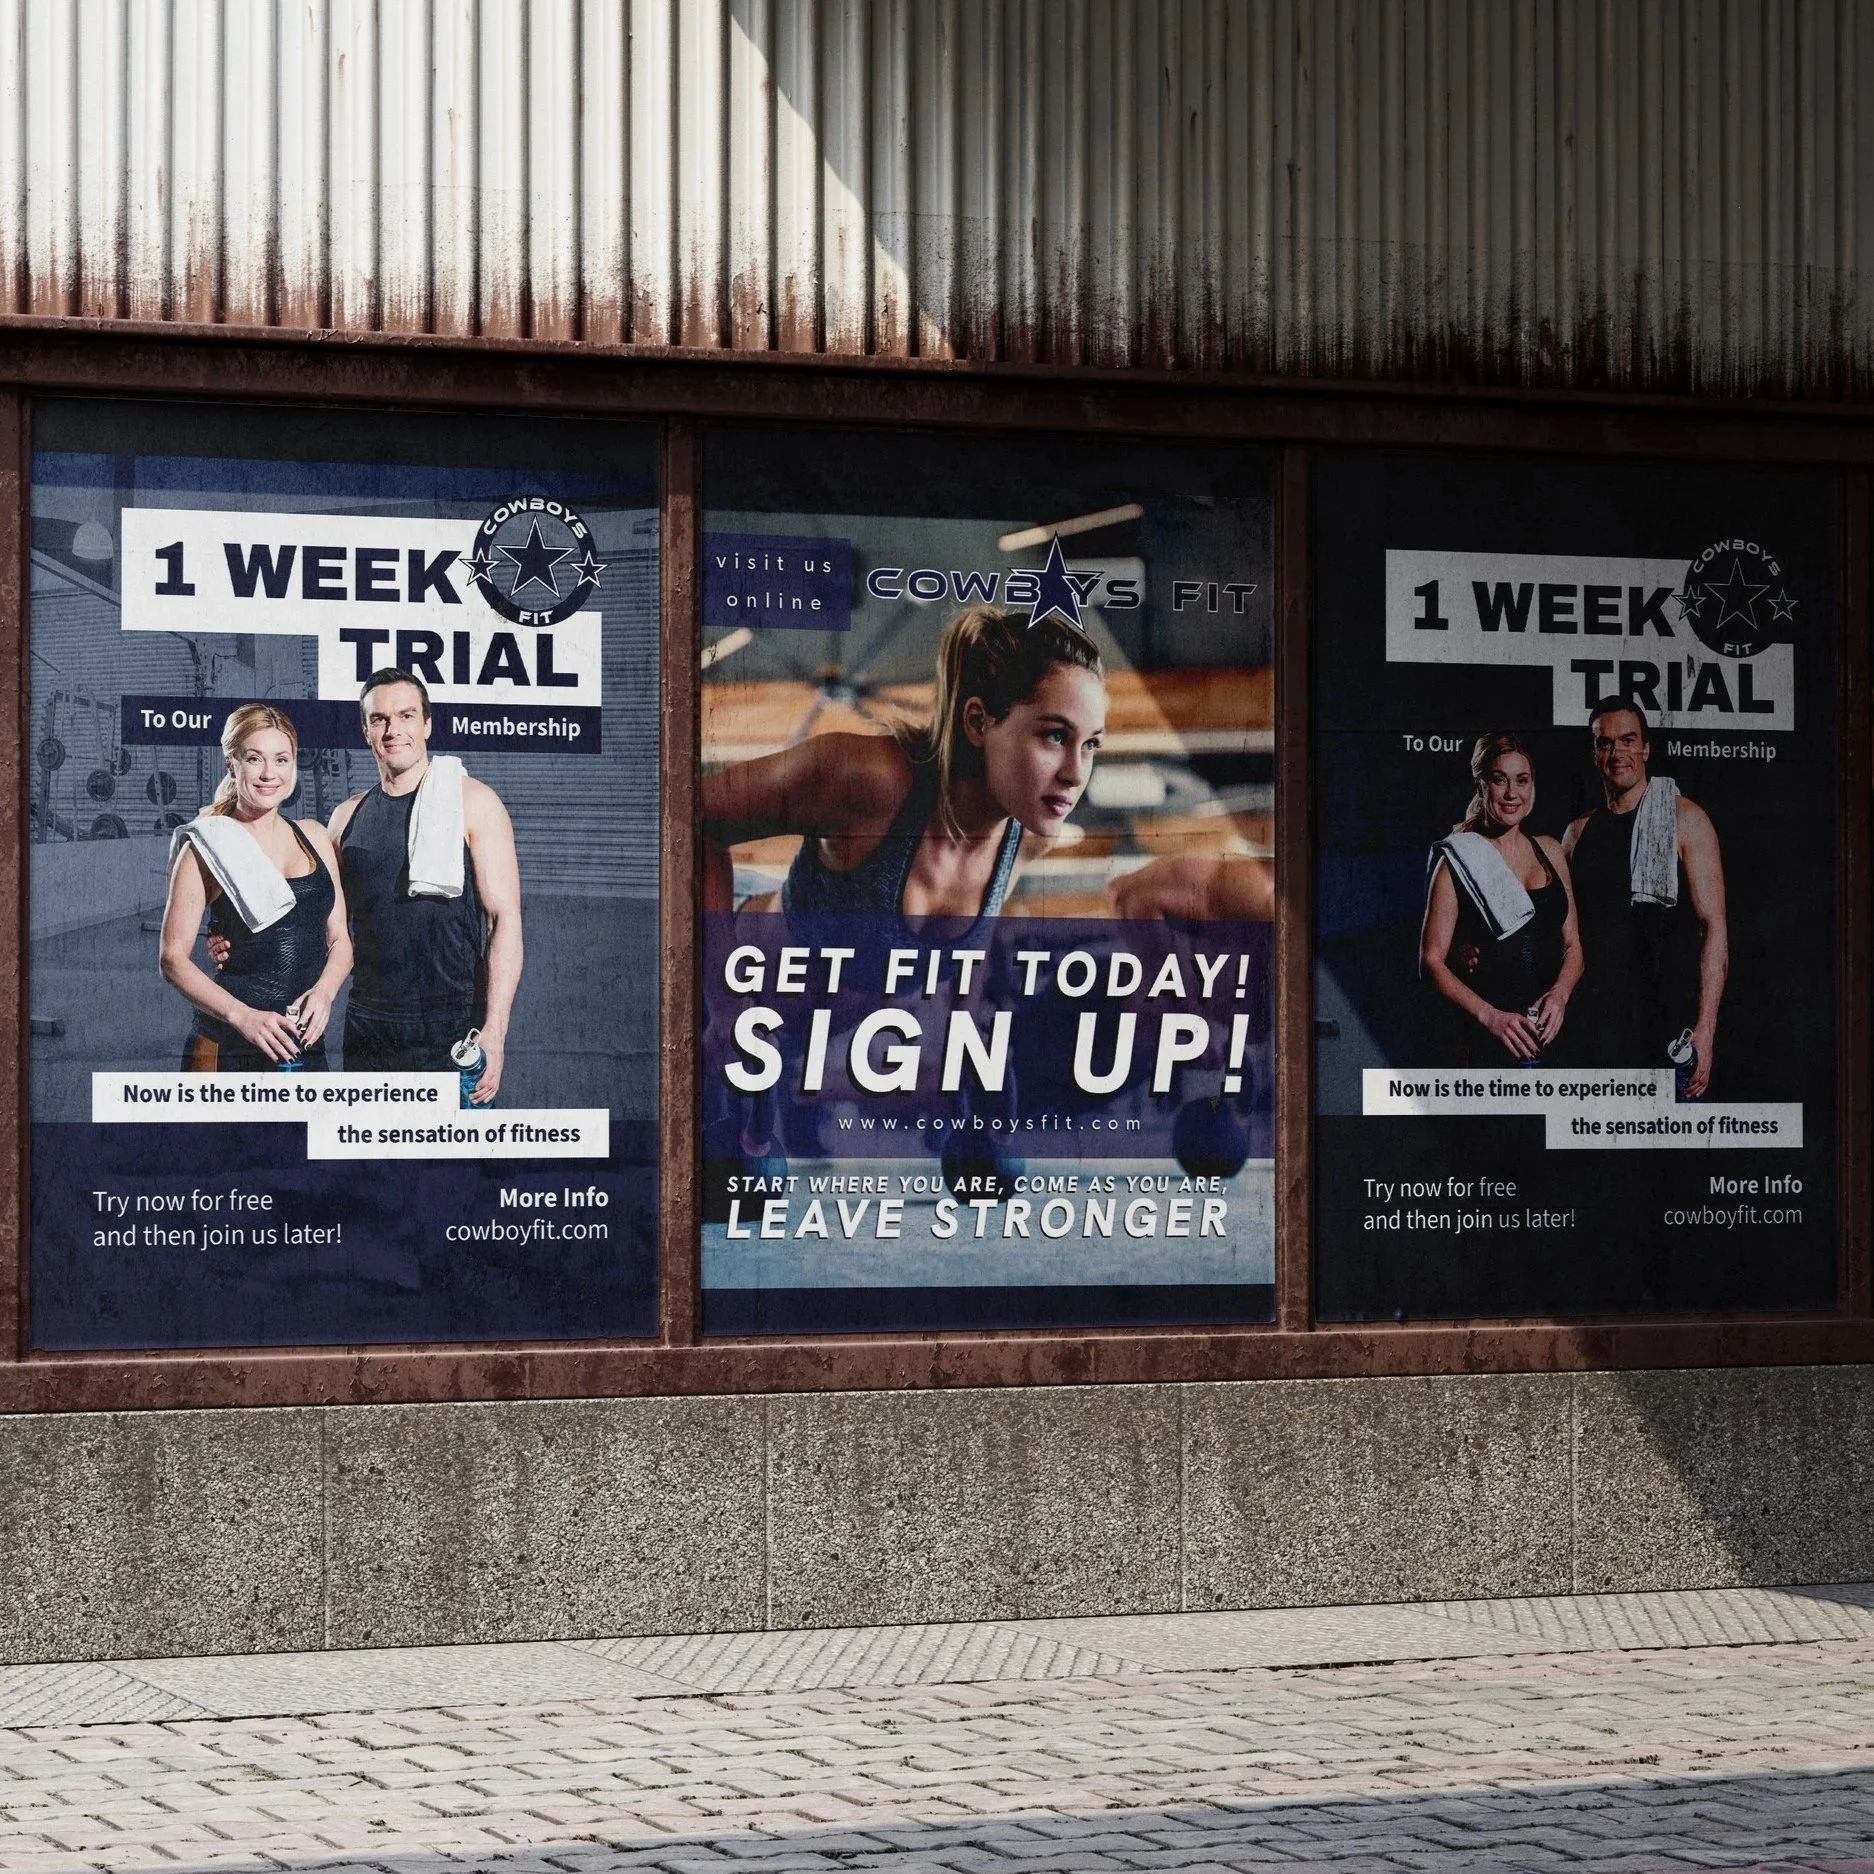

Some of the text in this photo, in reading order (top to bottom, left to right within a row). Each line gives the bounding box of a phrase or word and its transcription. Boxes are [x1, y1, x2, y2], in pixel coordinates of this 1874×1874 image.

[483, 497, 589, 539] COWBOYS
[716, 554, 832, 572] visit us
[1693, 539, 1782, 577] COWBOYS
[155, 541, 463, 604] 1 WEEK
[727, 591, 821, 611] online
[1173, 580, 1257, 614] FIT
[1413, 580, 1676, 637] 1 WEEK
[519, 610, 553, 625] FIT
[339, 628, 579, 688] TRIAL
[1723, 642, 1752, 655] FIT
[1570, 658, 1775, 714] TRIAL
[141, 710, 212, 730] To Our
[452, 717, 581, 741] Membership
[1403, 735, 1463, 752] To Our
[1668, 741, 1776, 762] Membership
[724, 945, 1251, 999] GET FIT TODAY!
[724, 1006, 1249, 1093] SIGN UP!
[123, 1084, 438, 1106] Now is the time to experience
[1389, 1079, 1657, 1100] Now is the time to experience
[337, 1123, 581, 1144] the sensation of fitness
[838, 1115, 1141, 1133] www.cowboysfit.com
[1571, 1116, 1778, 1135] the sensation of fitness
[727, 1176, 1227, 1195] START WHERE YOU ARE, COME AS YOU ARE,
[1363, 1177, 1517, 1202] Try now for free
[1710, 1175, 1803, 1195] More Info
[93, 1189, 273, 1217] Try now for free
[500, 1187, 609, 1208] More Info
[726, 1199, 1228, 1239] LEAVE STRONGER
[1363, 1208, 1575, 1234] and then join us later!
[1664, 1206, 1803, 1229] cowboyfit.com
[93, 1222, 342, 1251] and then join us later!
[445, 1219, 609, 1246] cowboyfit.com
